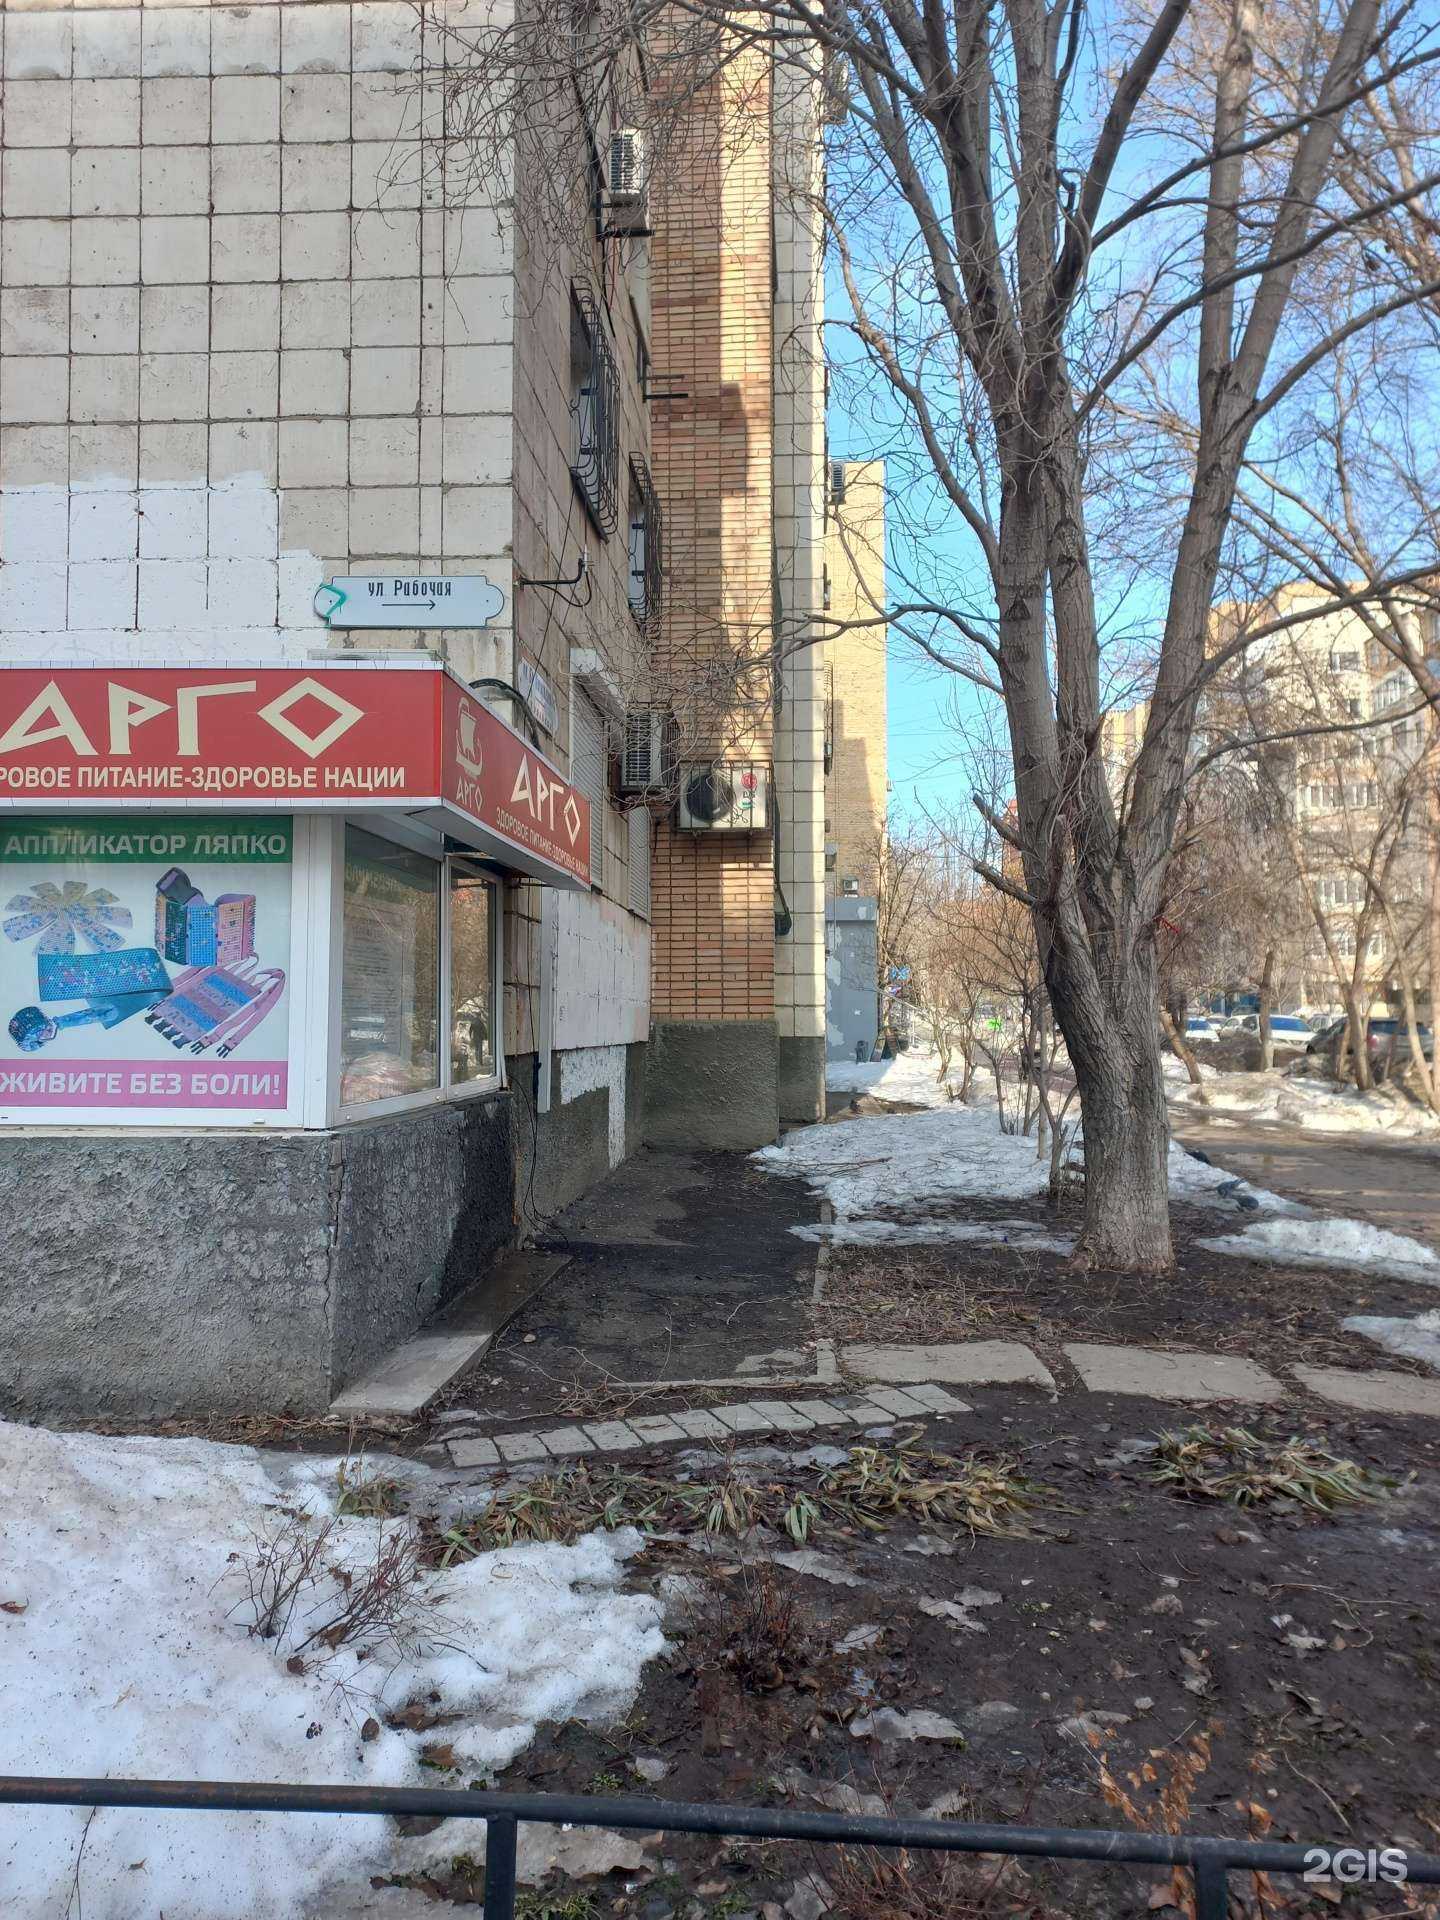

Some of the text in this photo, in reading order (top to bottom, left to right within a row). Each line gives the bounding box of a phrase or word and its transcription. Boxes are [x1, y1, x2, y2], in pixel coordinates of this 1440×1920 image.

[368, 580, 452, 597] ул Рабочая
[0, 677, 366, 759] АРГО
[77, 766, 317, 791] ПИТАНИЕ-ЗДОРОВЬЕ
[324, 766, 405, 791] НАЦИИ
[456, 775, 483, 813] АРГО
[510, 751, 581, 847] АРГО
[4, 834, 287, 855] АППЛИКАТОР ЛЯПКО
[0, 1072, 281, 1095] ЖИВИТЕ БЕЗ БОЛИ!
